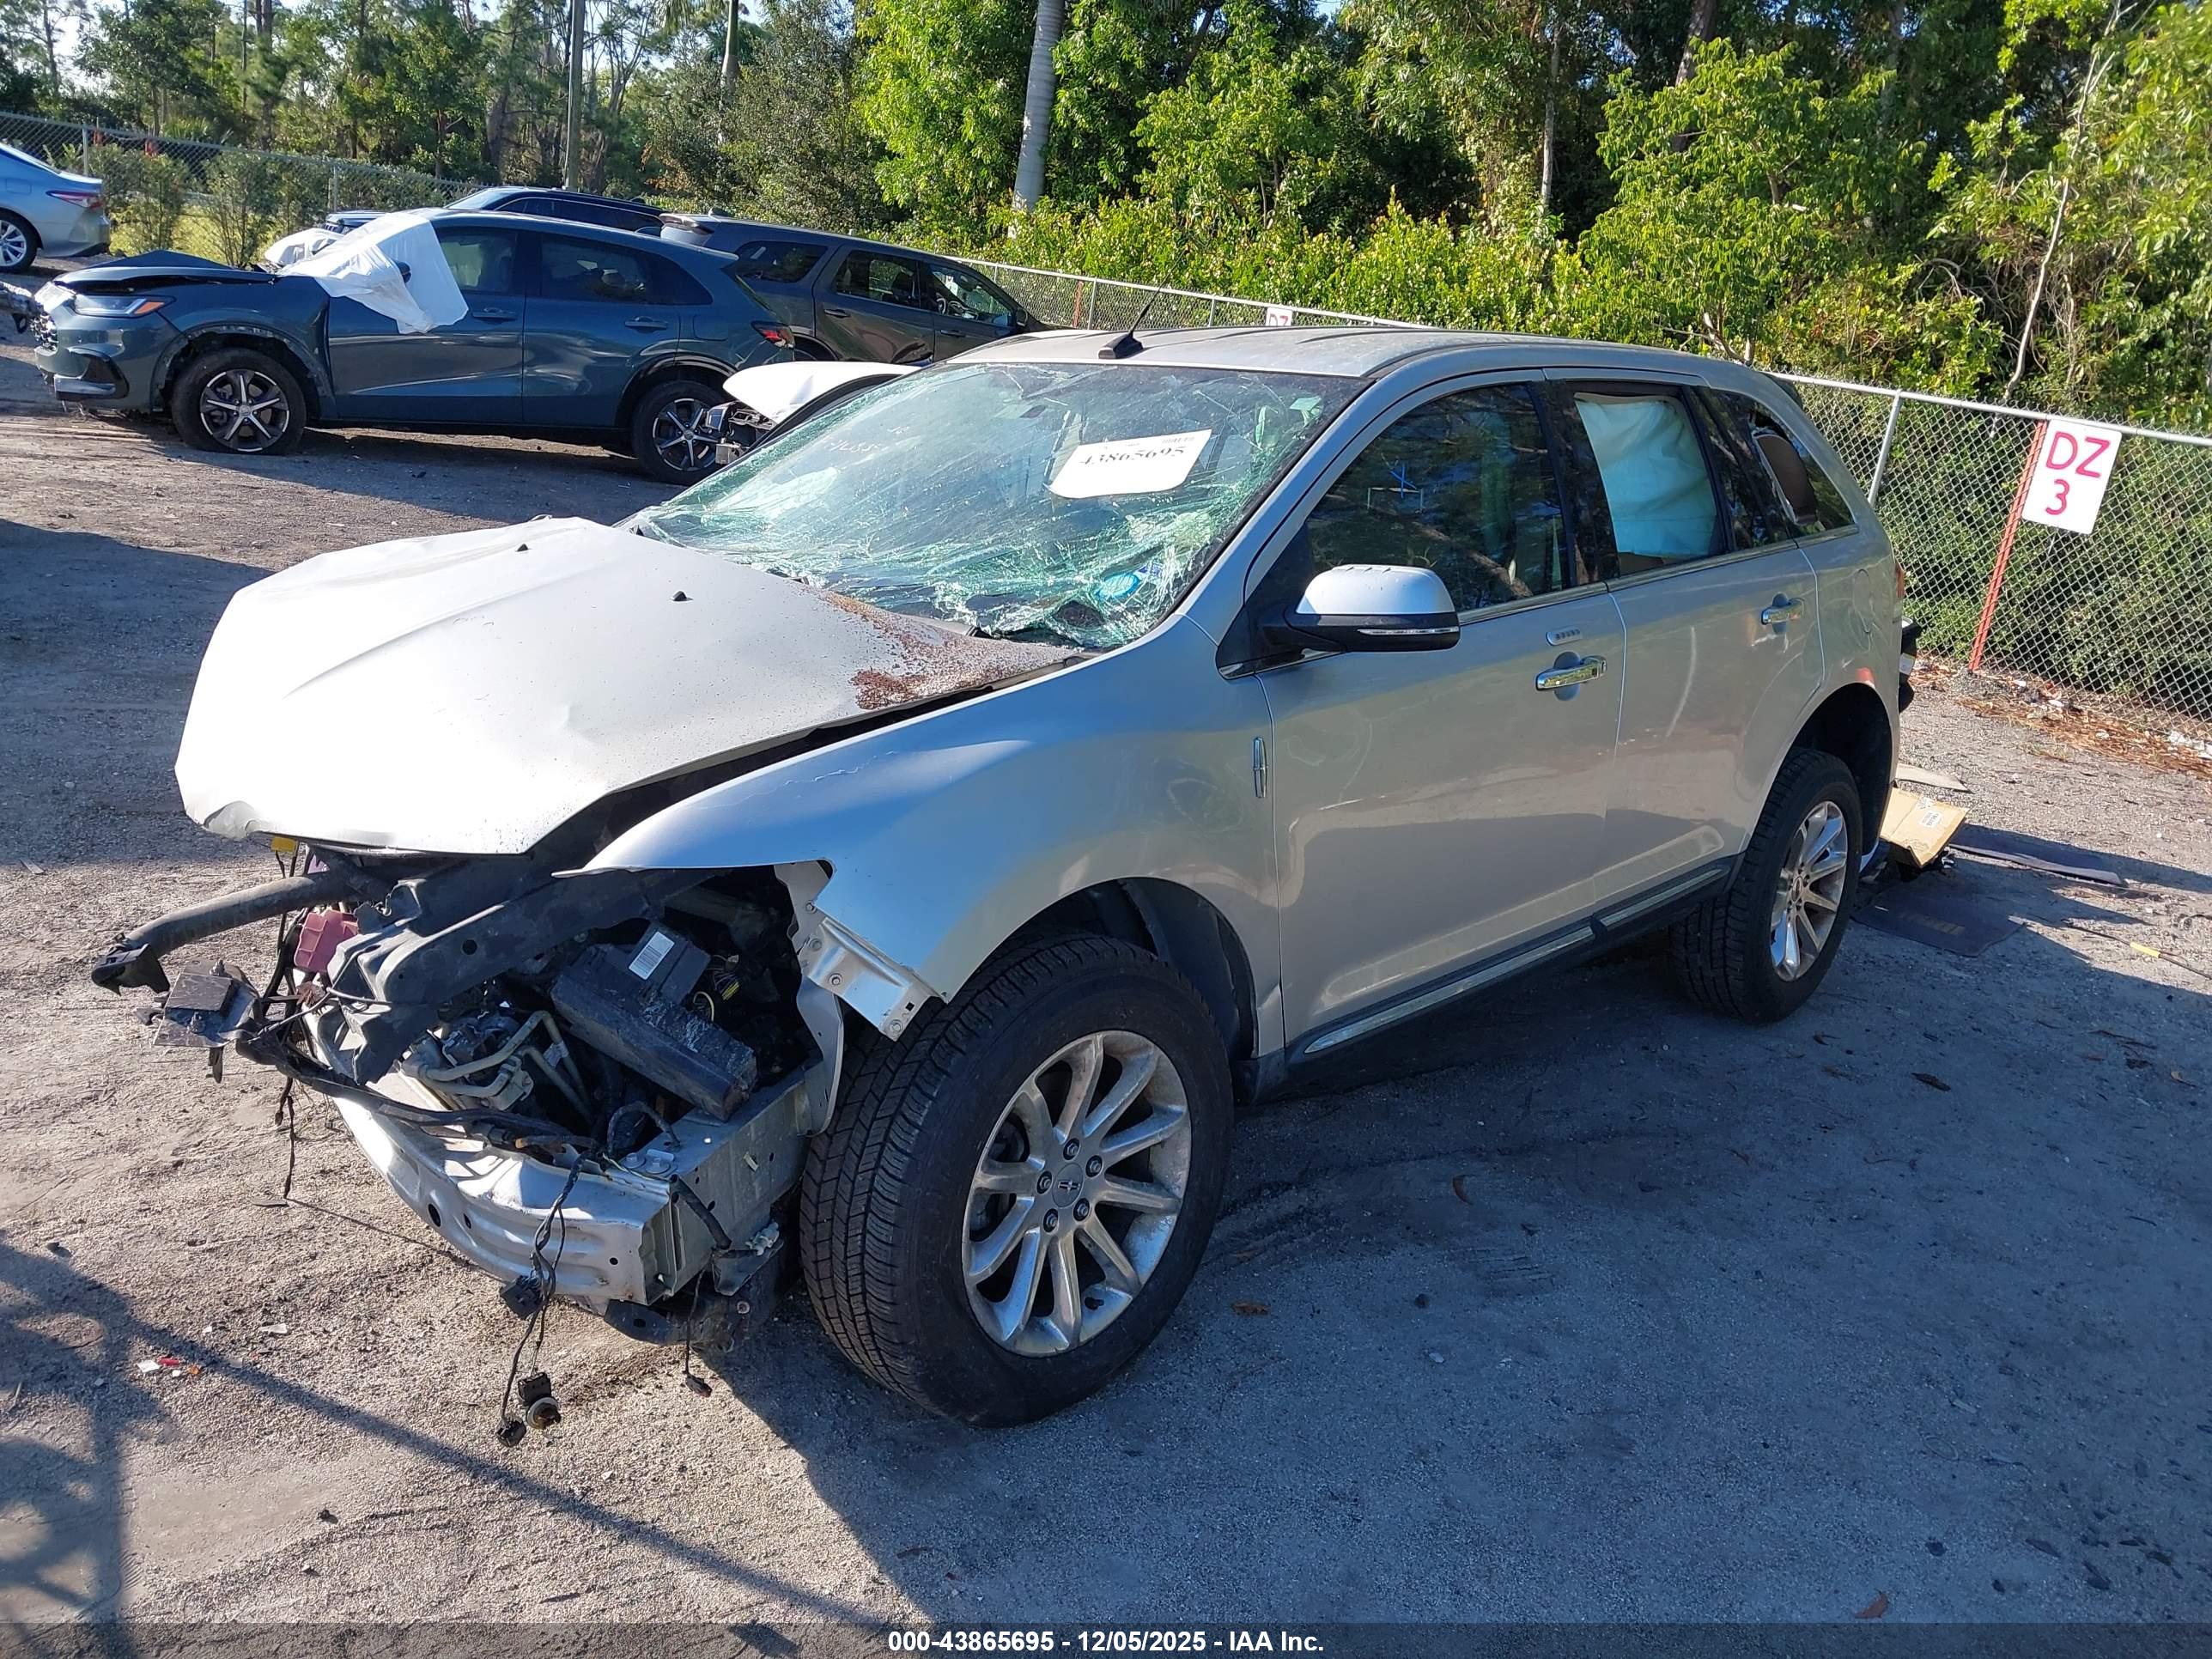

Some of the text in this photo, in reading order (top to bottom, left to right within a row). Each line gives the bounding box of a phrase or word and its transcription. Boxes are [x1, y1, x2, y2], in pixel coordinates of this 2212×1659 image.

[1079, 446, 1188, 466] 43865695
[2046, 431, 2110, 478] DZ
[2046, 478, 2070, 516] 3
